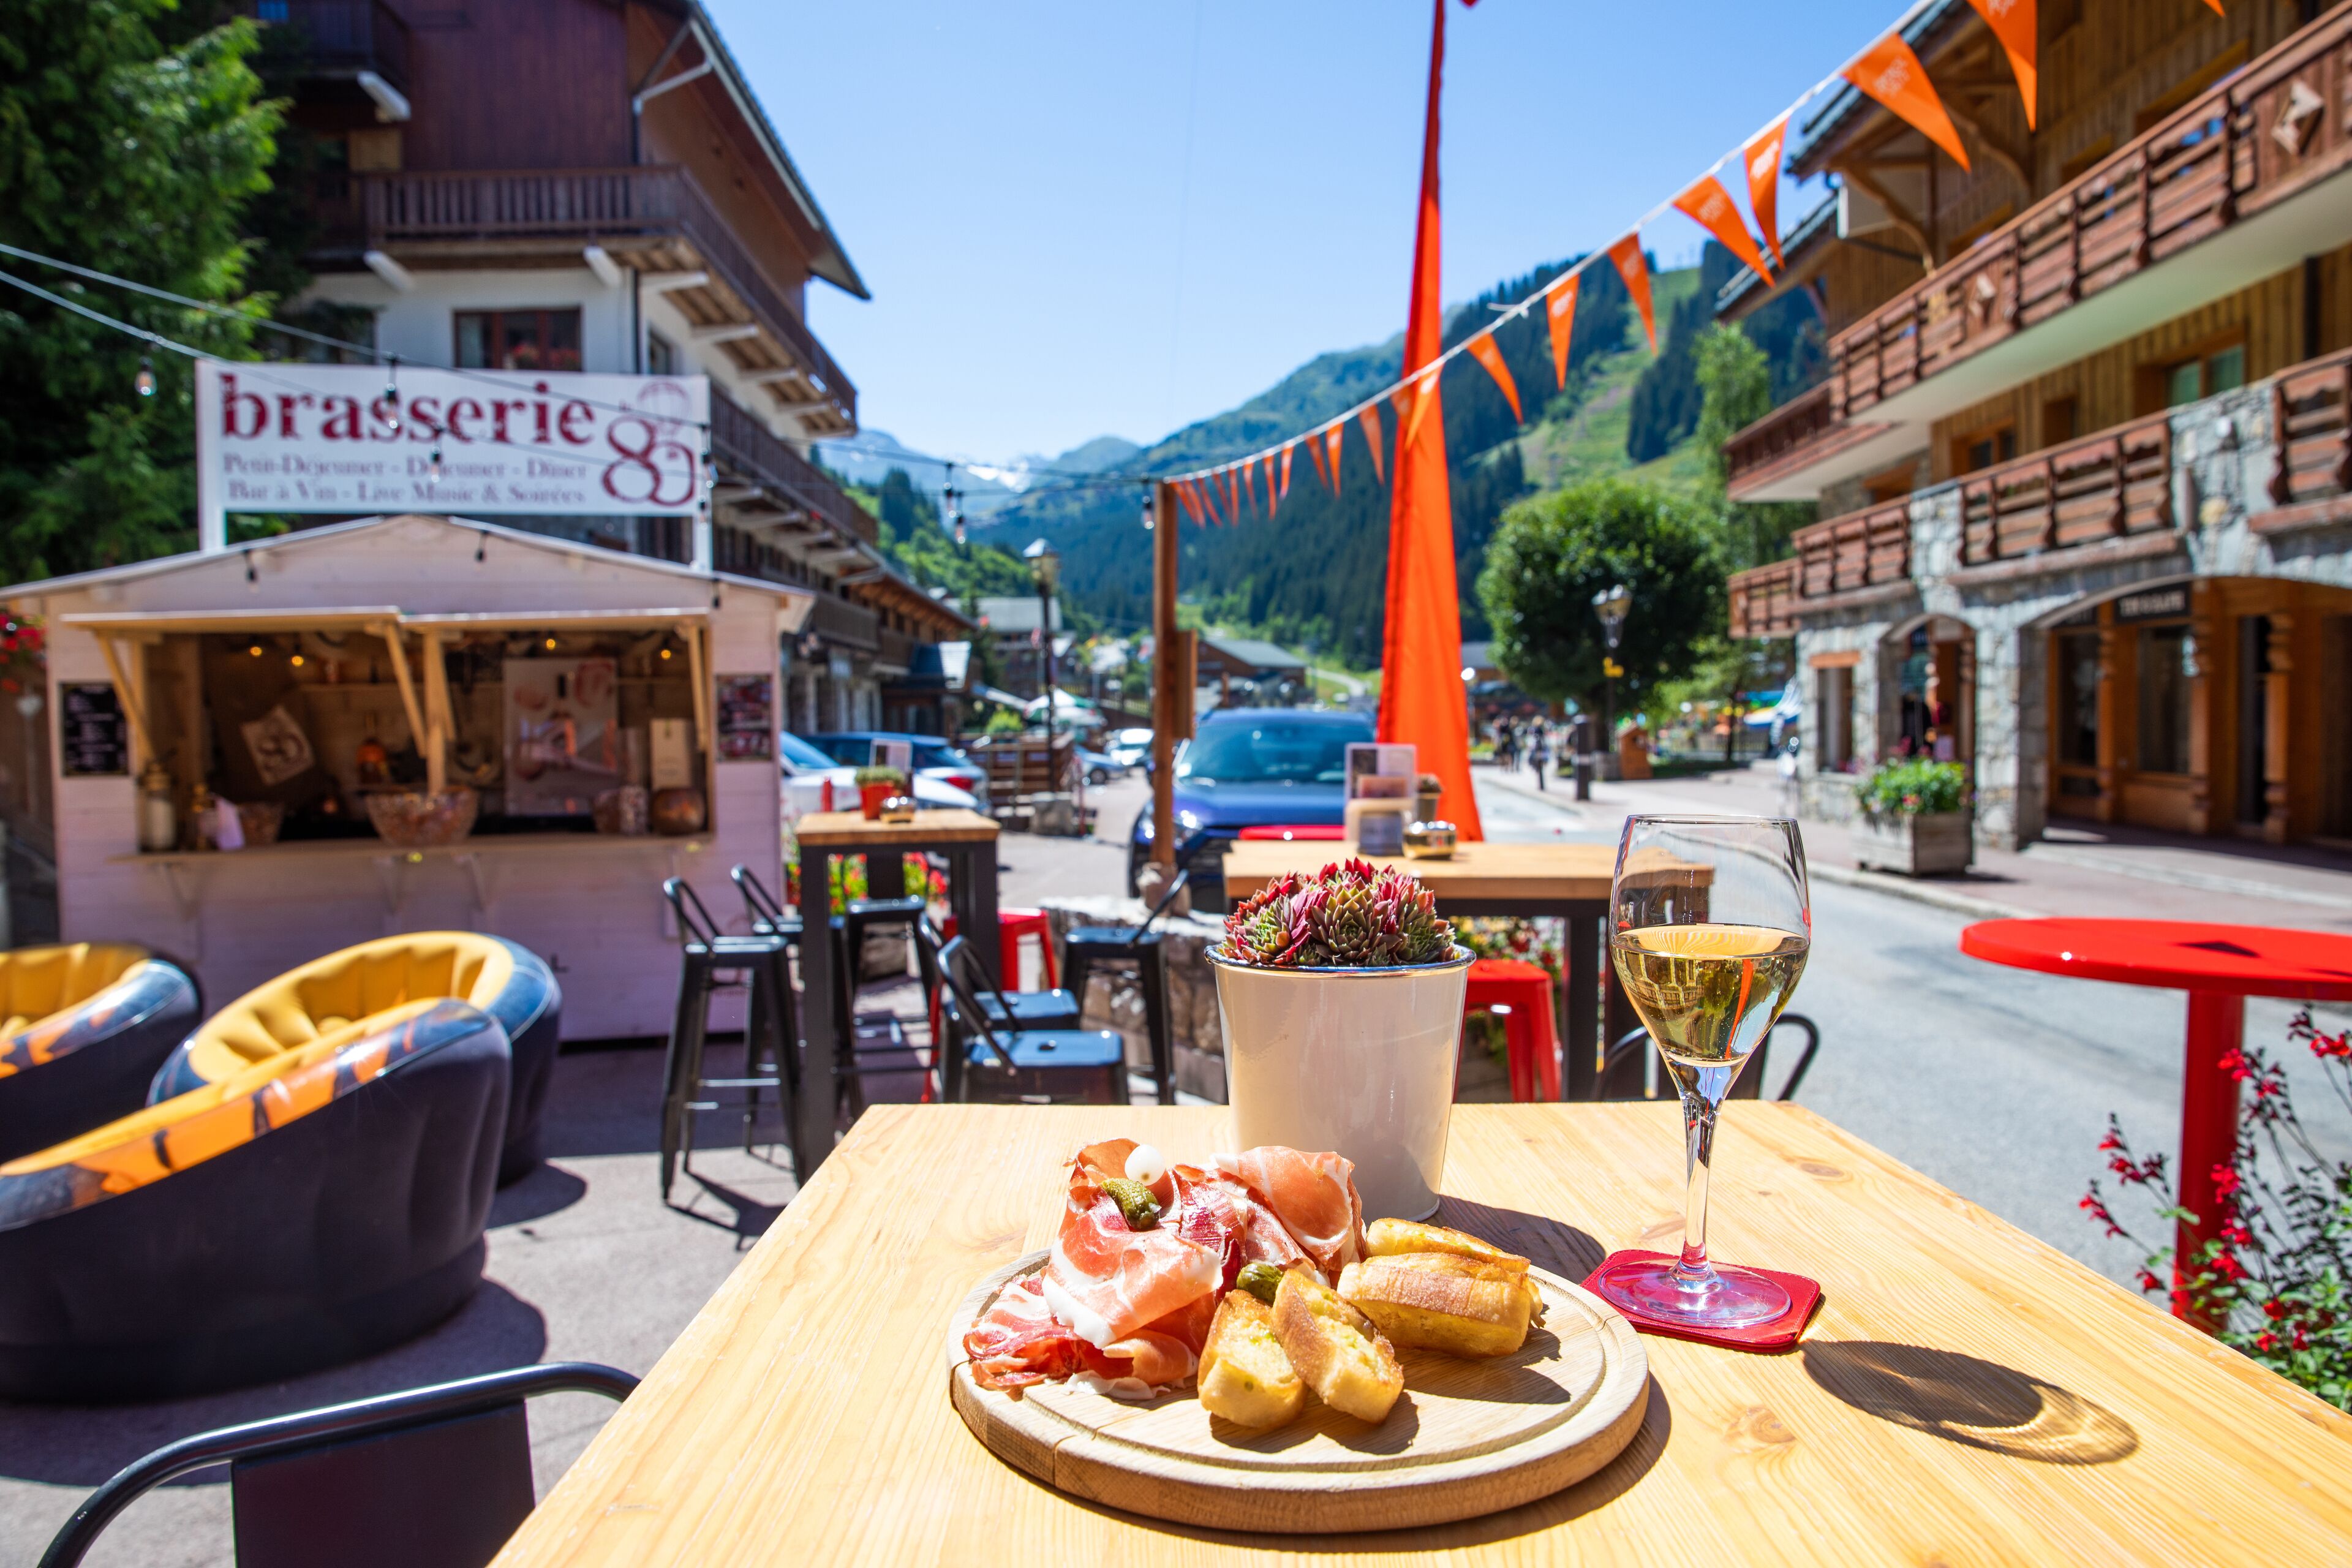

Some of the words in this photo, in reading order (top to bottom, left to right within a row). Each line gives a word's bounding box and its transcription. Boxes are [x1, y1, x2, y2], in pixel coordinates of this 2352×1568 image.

[220, 372, 595, 445] brasserie
[228, 480, 268, 500] Bar
[295, 478, 337, 501] Vin
[357, 480, 405, 502] Live
[412, 481, 474, 503] Music
[481, 483, 502, 505] &
